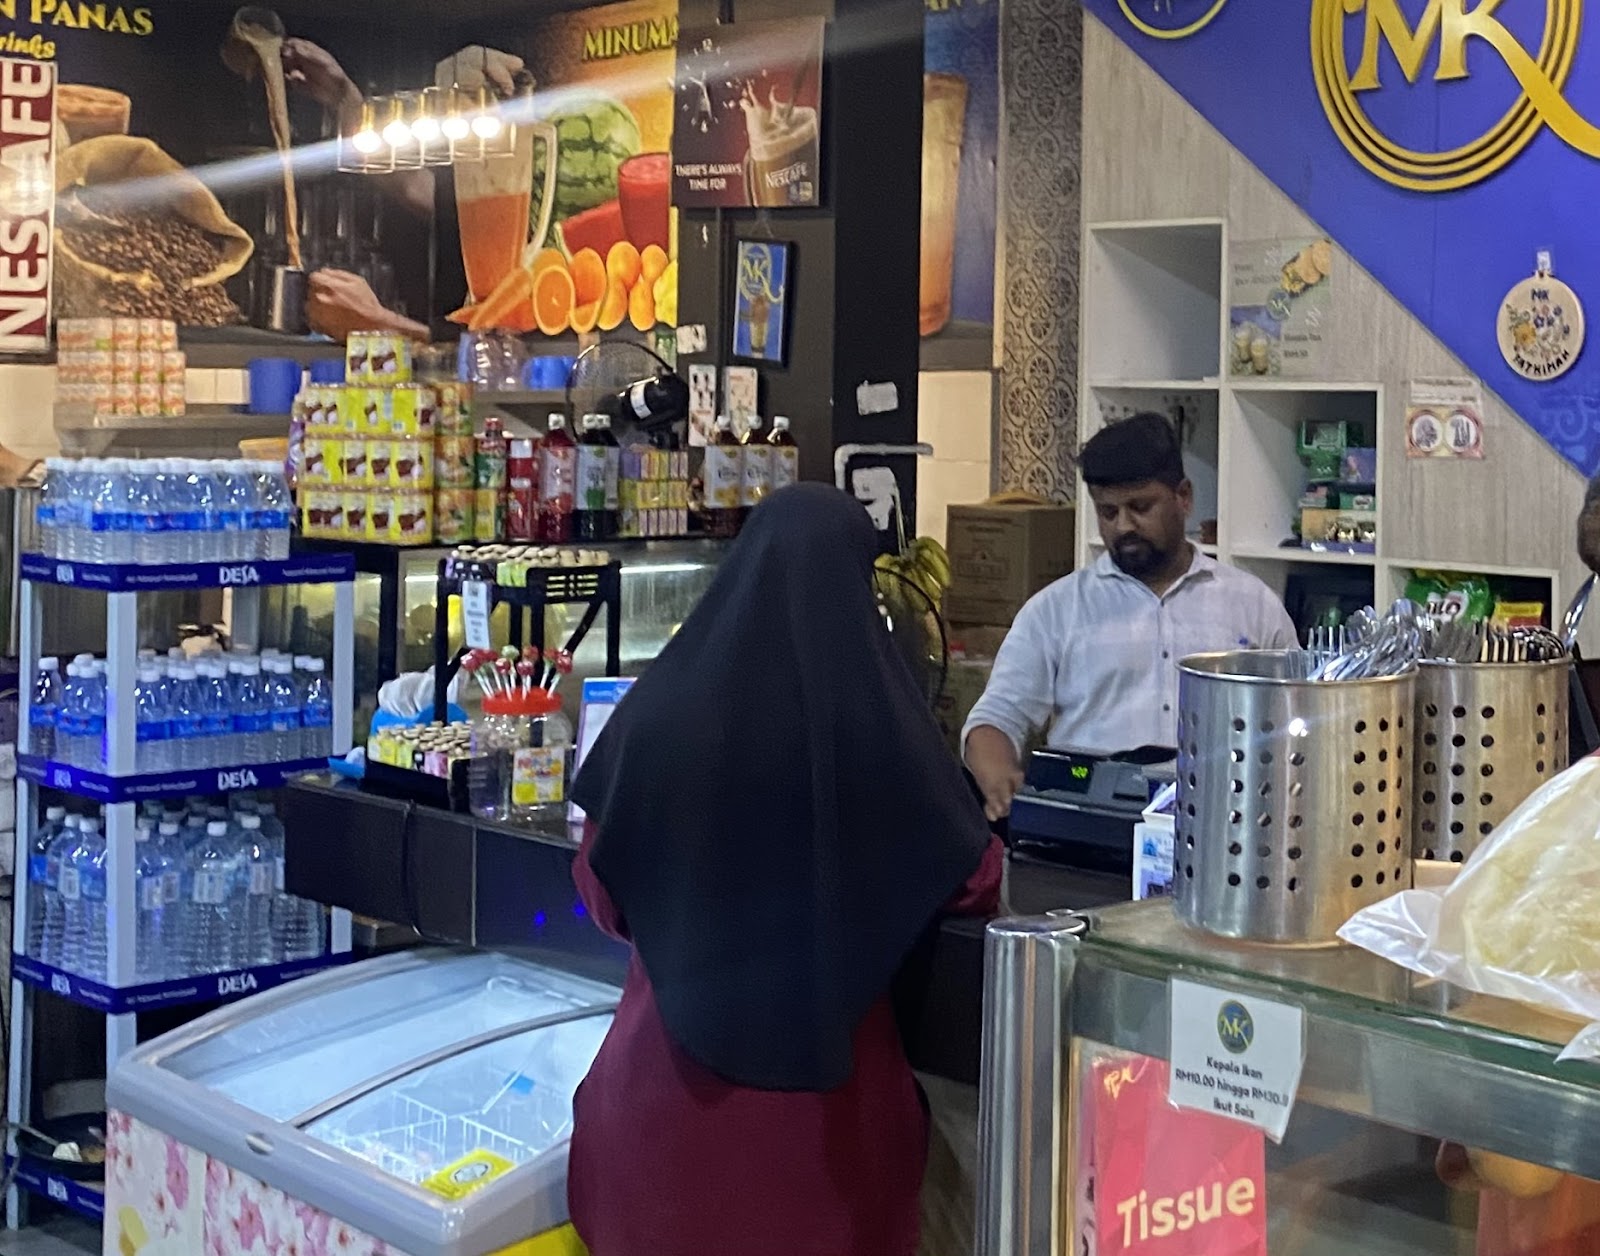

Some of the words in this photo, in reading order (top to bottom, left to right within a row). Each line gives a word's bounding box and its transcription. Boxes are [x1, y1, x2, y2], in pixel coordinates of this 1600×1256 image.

[30, 0, 154, 35] PANAS
[689, 178, 709, 191] TIME
[709, 178, 727, 190] FOR
[219, 565, 259, 585] DESA
[218, 768, 258, 790] DESA
[218, 972, 257, 995] DESA
[1206, 1056, 1240, 1075] Kepala
[1242, 1064, 1263, 1079] Ikan
[1175, 1068, 1215, 1088] RM10.00
[1216, 1078, 1250, 1098] hingga
[1213, 1097, 1233, 1113] Ikut
[1116, 1177, 1256, 1248] Tissue
